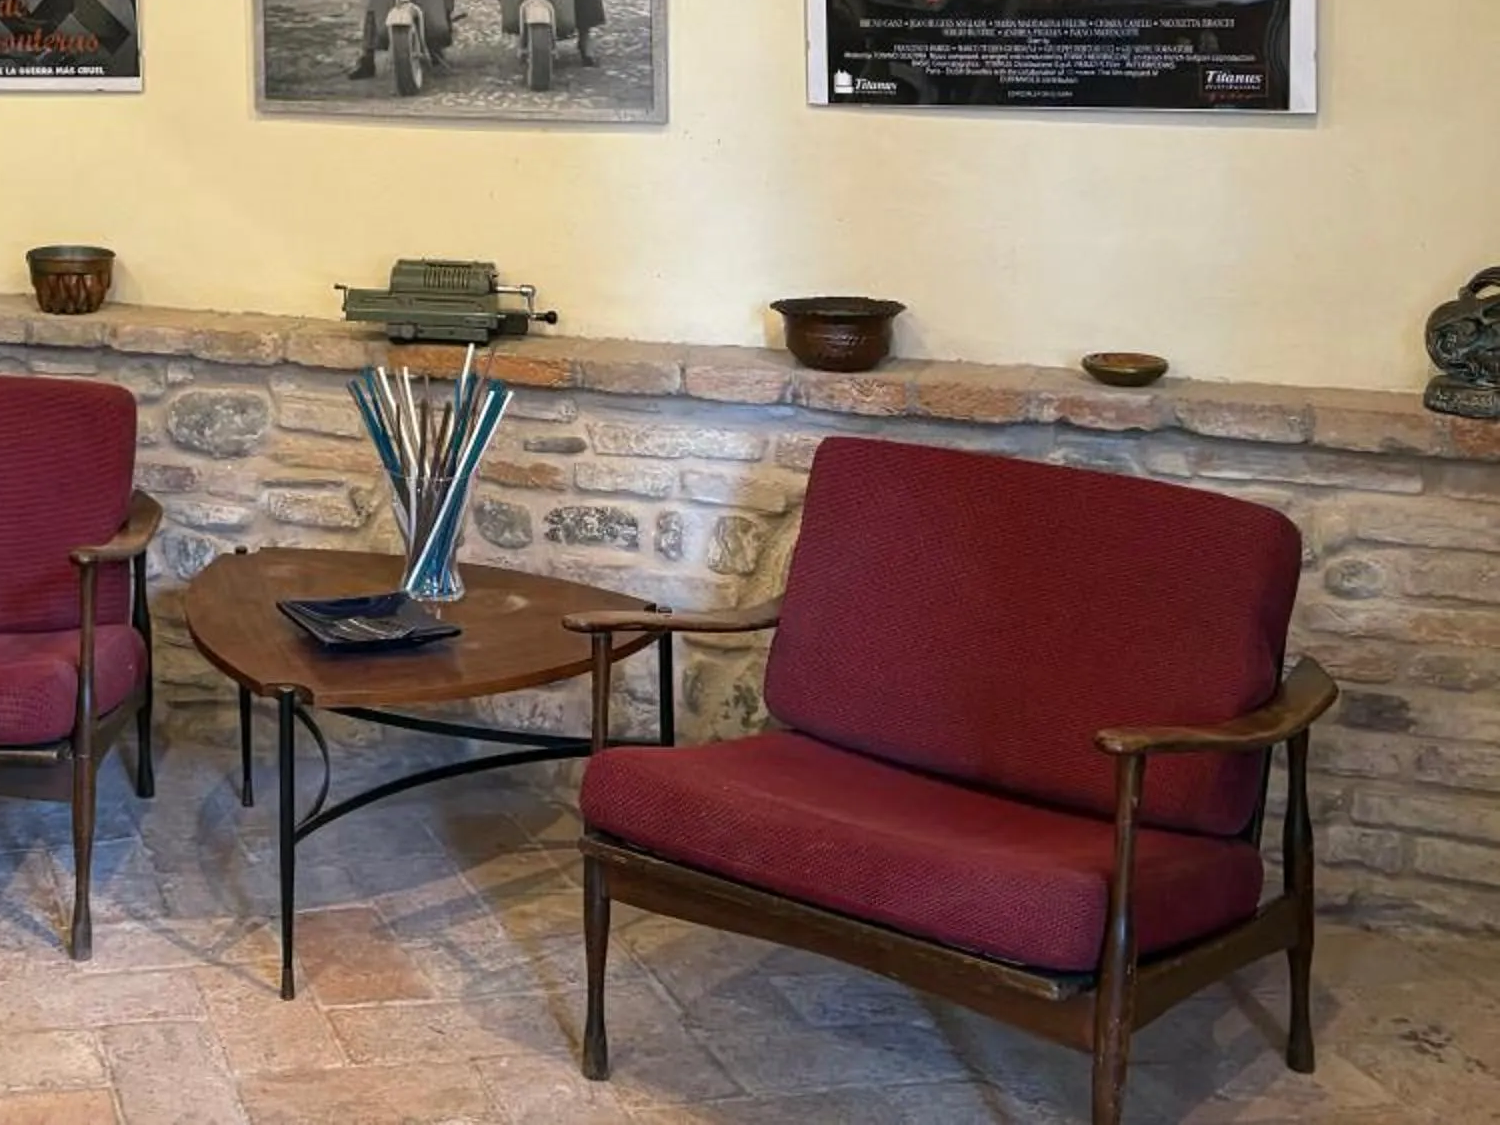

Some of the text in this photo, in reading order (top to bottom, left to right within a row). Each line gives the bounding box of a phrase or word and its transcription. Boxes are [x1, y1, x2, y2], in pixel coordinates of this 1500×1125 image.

[5, 66, 16, 75] LA
[1204, 70, 1265, 84] Titanus
[855, 78, 897, 90] Titanus
